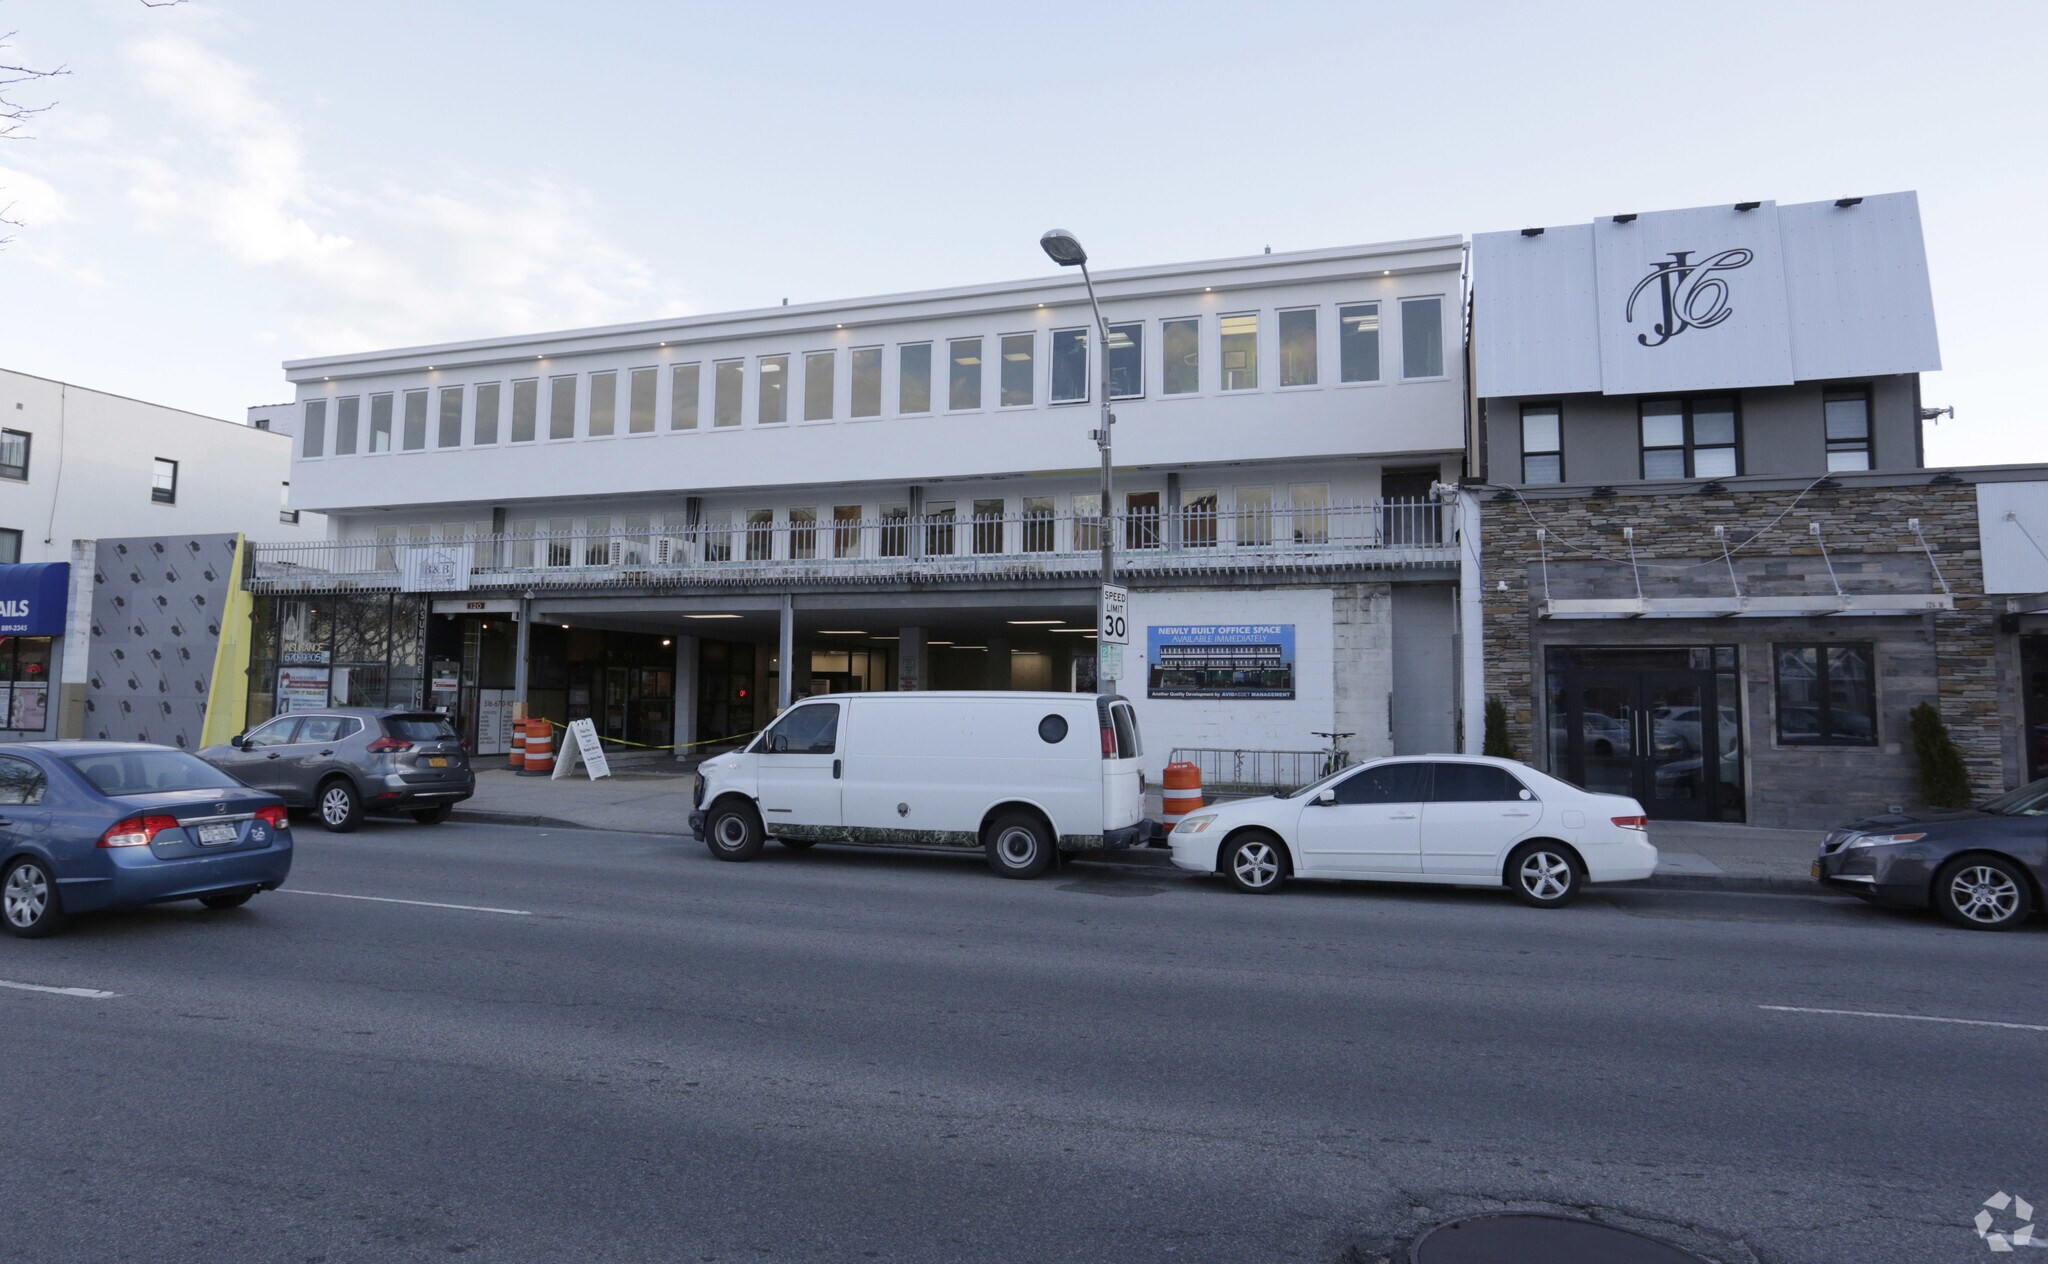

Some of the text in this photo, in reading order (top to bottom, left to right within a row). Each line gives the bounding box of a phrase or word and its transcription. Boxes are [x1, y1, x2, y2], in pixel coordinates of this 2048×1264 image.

[1105, 591, 1126, 603] SPEED
[1106, 603, 1123, 613] LIMIT
[1105, 615, 1126, 638] 30
[1158, 626, 1281, 635] NEWLY BUILT OFFICE SPACE
[417, 595, 425, 674] NSURANCE
[1172, 635, 1267, 643] AVAILABLE IMMEDIATELY
[283, 642, 323, 652] INSURANCE
[285, 652, 321, 662] 670-9305
